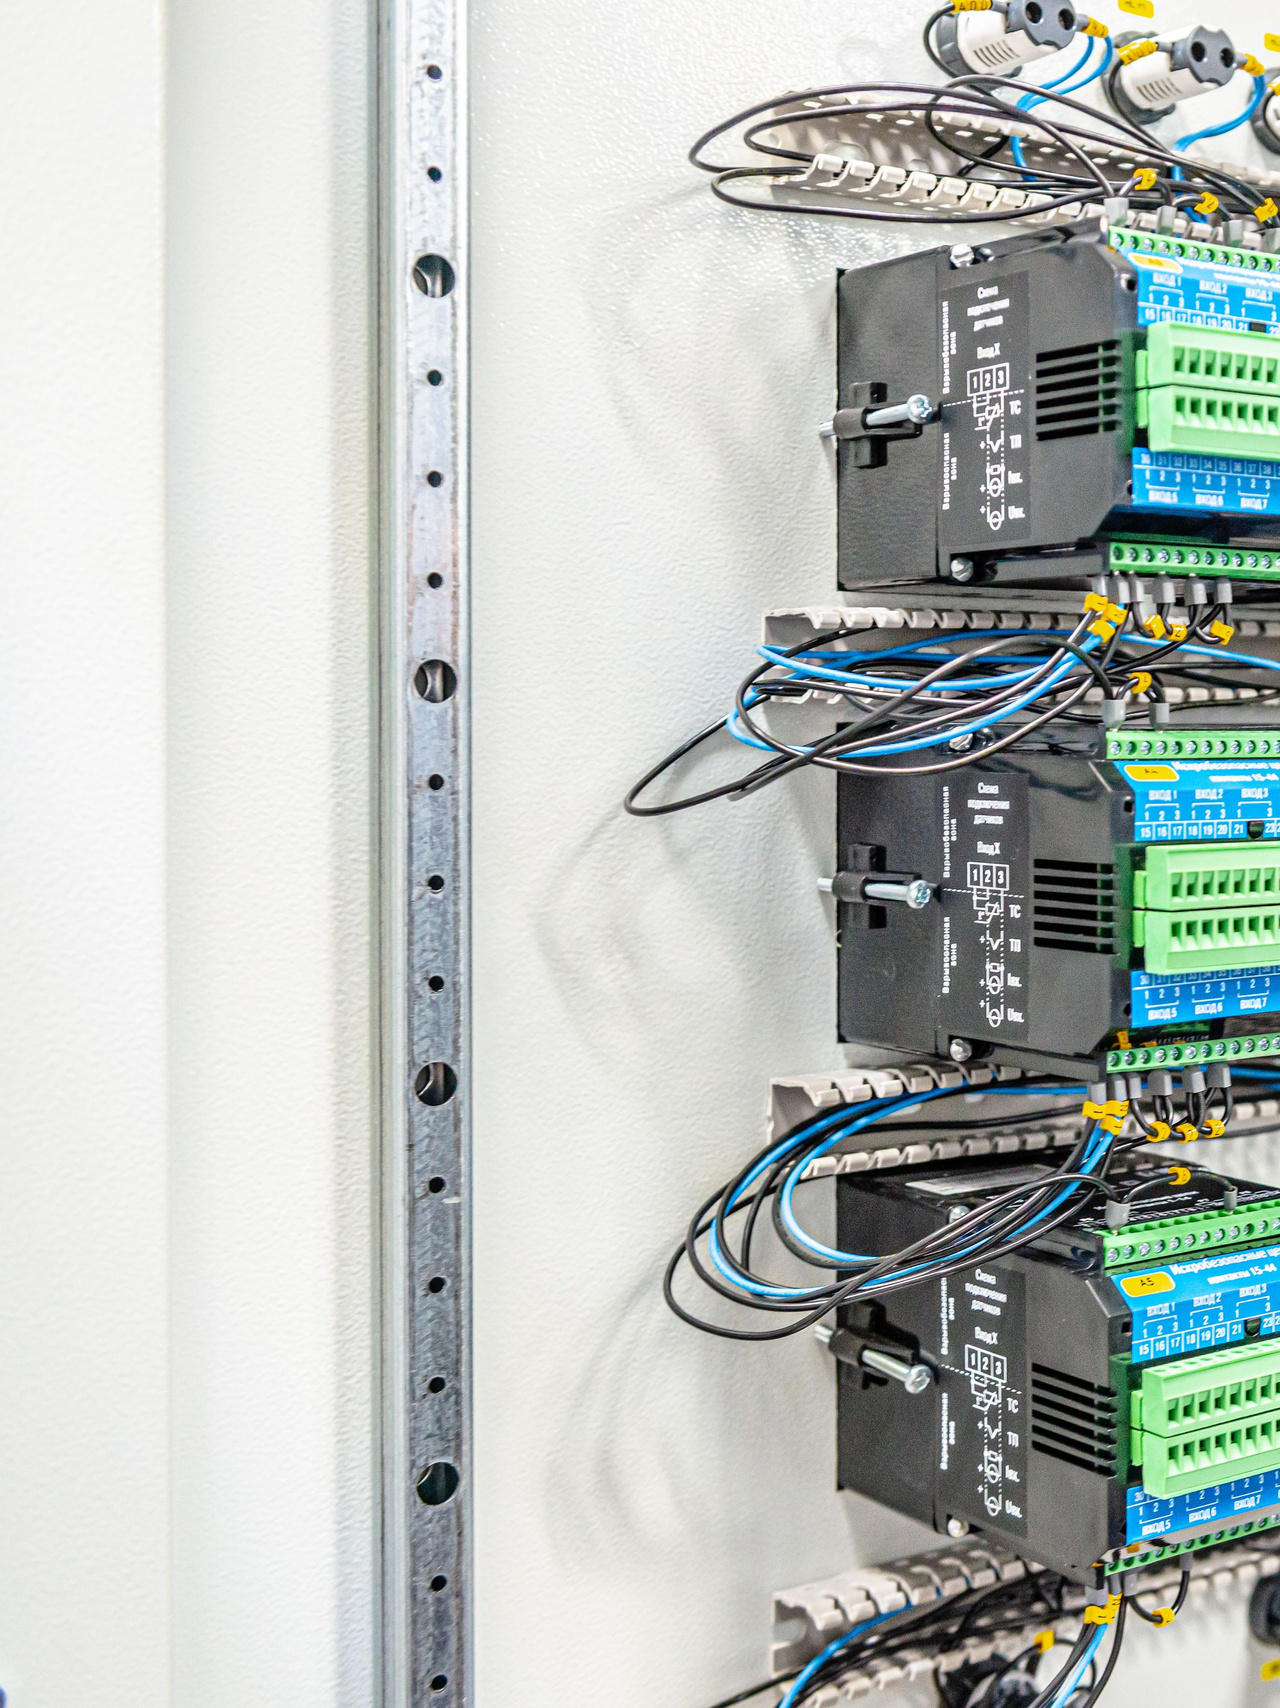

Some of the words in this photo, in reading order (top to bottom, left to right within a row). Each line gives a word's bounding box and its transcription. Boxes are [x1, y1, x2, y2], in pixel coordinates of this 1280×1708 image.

[1153, 272, 1176, 287] ВХОД
[1200, 280, 1220, 293] ВХОД
[1245, 287, 1267, 301] ВХОД
[1145, 308, 1155, 320] 15
[973, 376, 977, 388] 1
[985, 373, 991, 387] 2
[998, 370, 1004, 384] 3
[1148, 490, 1171, 504] ВХОД
[1196, 494, 1218, 507] ВХОД
[1240, 498, 1262, 510] ВХОД
[1149, 790, 1172, 801] ВХОД
[1195, 789, 1217, 800] ВХОД
[1241, 788, 1263, 799] ВХОД
[1141, 827, 1151, 837] 15
[1157, 826, 1167, 837] 16
[1173, 826, 1182, 836] 17
[1188, 826, 1198, 835] 18
[1203, 825, 1213, 835] 19
[1218, 825, 1227, 834] 20
[1234, 824, 1243, 834] 21
[1265, 823, 1274, 833] 23
[973, 869, 977, 881] 1
[985, 870, 991, 882] 2
[998, 871, 1004, 884] 3
[1240, 998, 1261, 1009] ВХОД
[1148, 1009, 1171, 1020] ВХОД
[1195, 1004, 1216, 1015] ВХОД
[1250, 1263, 1277, 1275] 15-44
[1239, 1285, 1261, 1297] ВХОД
[1193, 1293, 1216, 1307] ВХОД
[1147, 1303, 1170, 1317] ВХОД
[1263, 1318, 1273, 1328] 23
[1216, 1328, 1225, 1338] 20
[1232, 1324, 1241, 1334] 21
[1186, 1334, 1196, 1344] 18
[1201, 1330, 1211, 1341] 19
[1155, 1341, 1165, 1351] 16
[1171, 1337, 1180, 1347] 17
[1139, 1344, 1149, 1355] 15
[971, 1353, 975, 1366] 1
[983, 1357, 988, 1370] 2
[995, 1361, 1001, 1374] 3
[1134, 1491, 1144, 1502] 30
[1234, 1496, 1256, 1510] ВХОД
[1189, 1508, 1211, 1523] ВХОД
[1142, 1522, 1165, 1536] ВХОД
